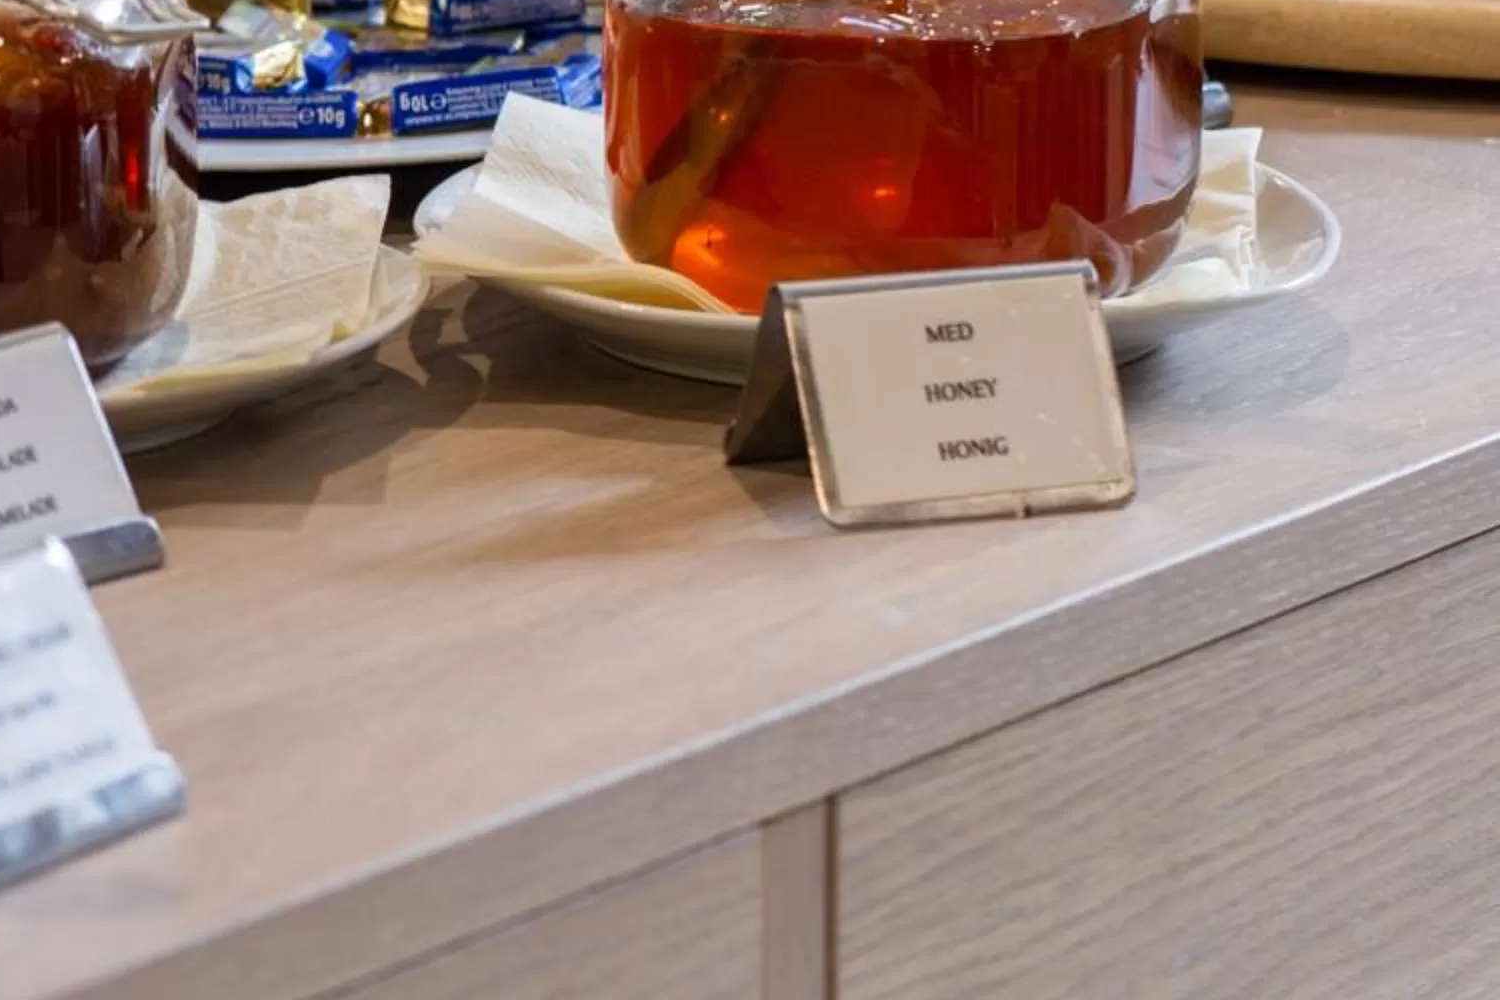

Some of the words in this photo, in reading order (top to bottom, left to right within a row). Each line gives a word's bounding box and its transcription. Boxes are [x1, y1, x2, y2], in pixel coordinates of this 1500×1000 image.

[316, 106, 345, 129] 10g
[924, 322, 974, 343] MED
[924, 378, 997, 403] HONEY
[938, 436, 1009, 461] HONIG
